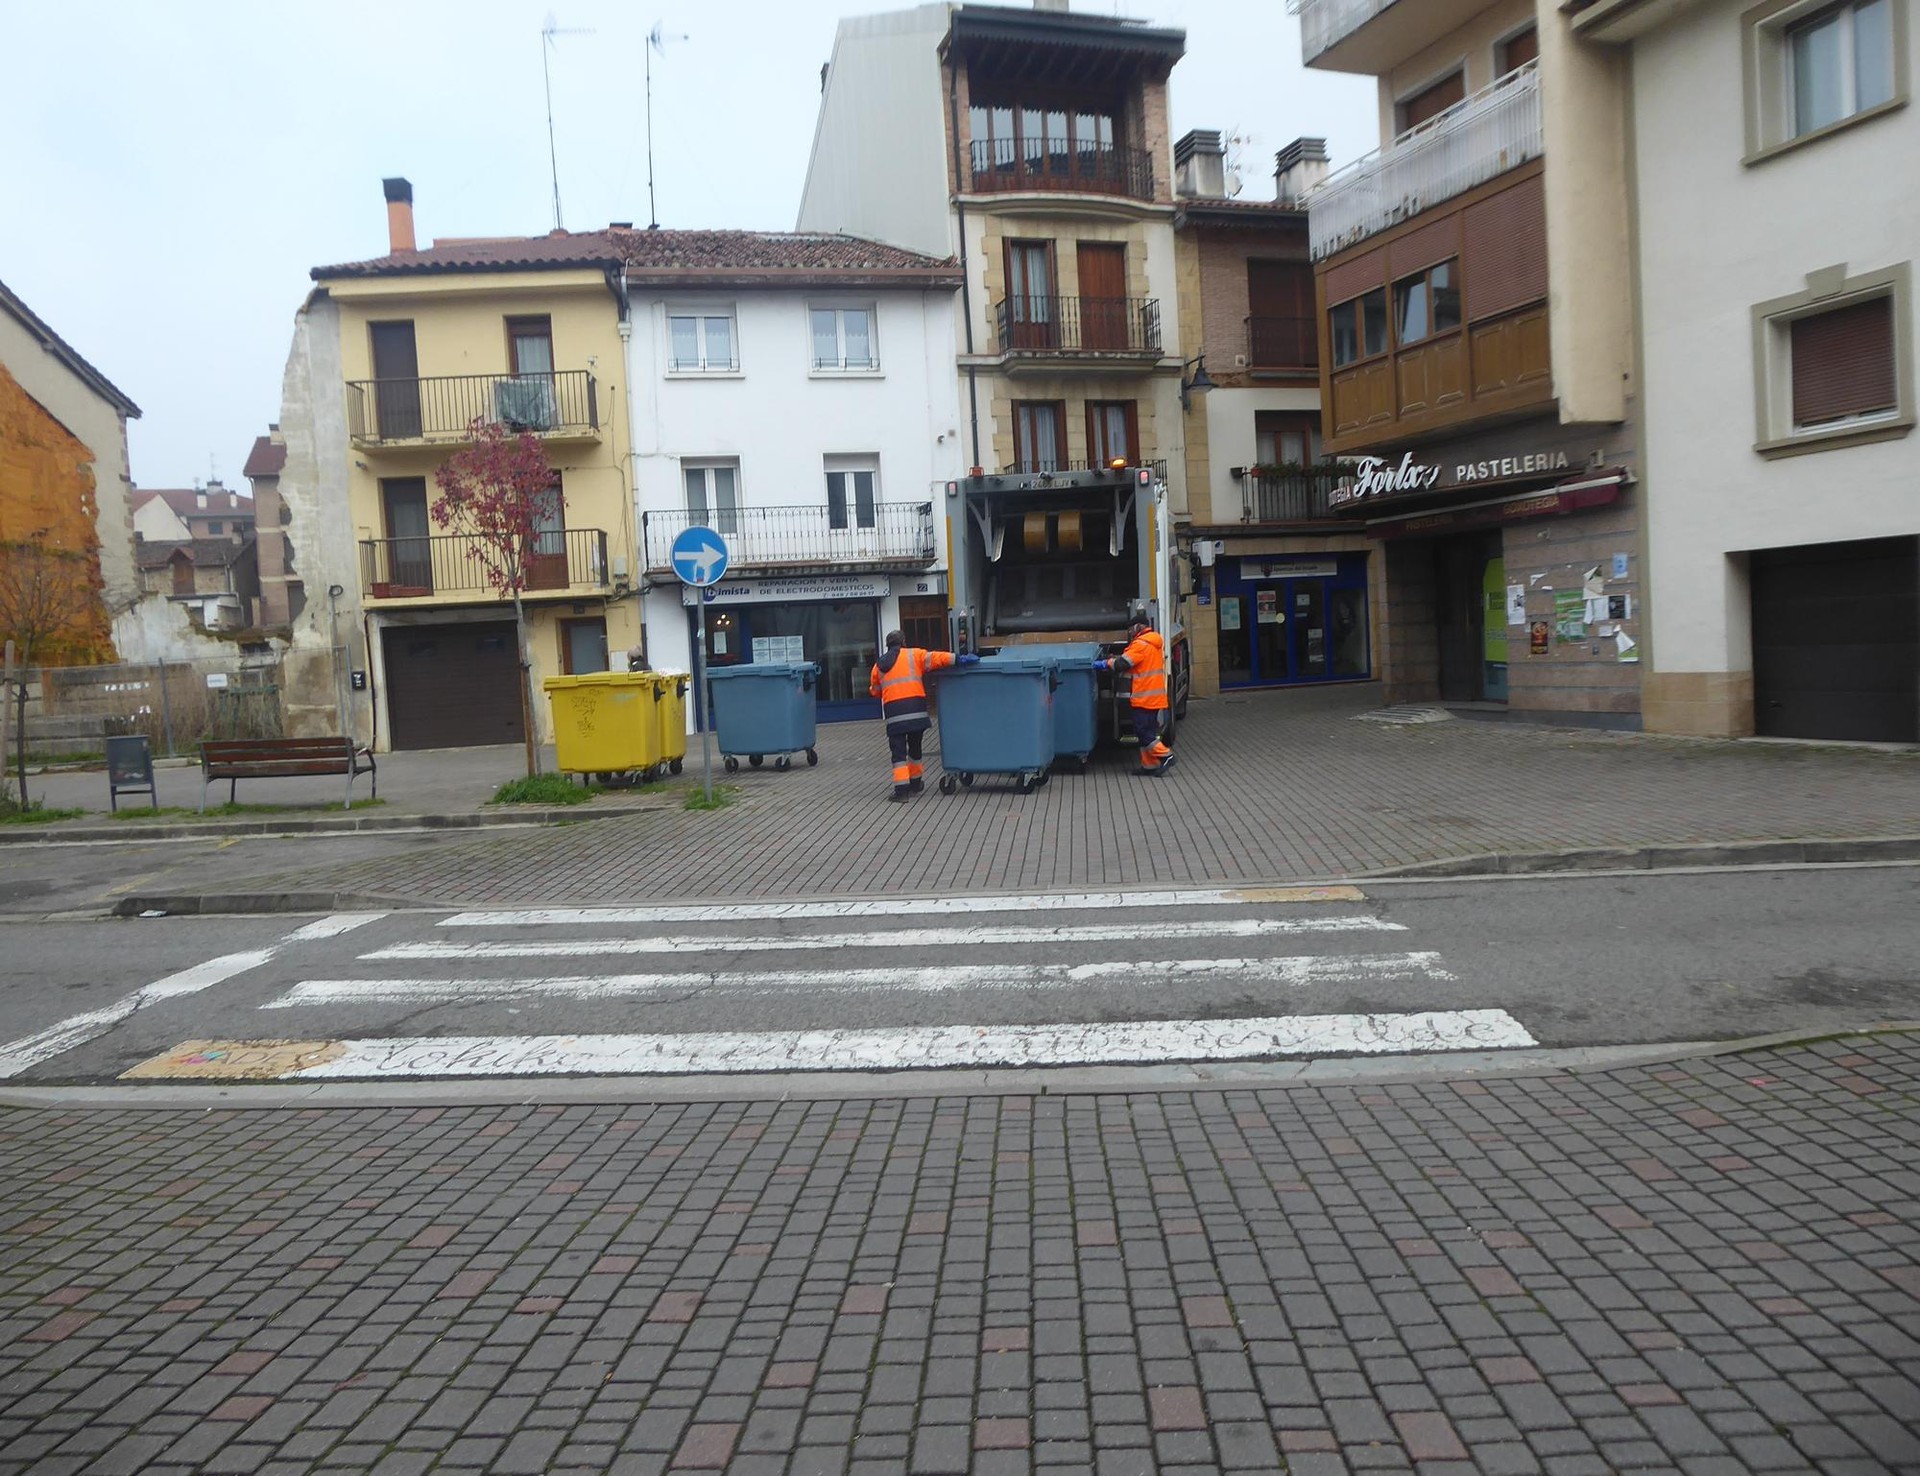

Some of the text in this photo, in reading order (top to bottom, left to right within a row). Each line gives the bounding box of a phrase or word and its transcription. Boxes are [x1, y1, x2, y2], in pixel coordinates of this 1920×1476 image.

[1456, 450, 1569, 484] PASTELERIA
[829, 576, 860, 584] VENTA
[759, 588, 772, 596] DE
[776, 584, 875, 596] ELECTRODOMESTICOS
